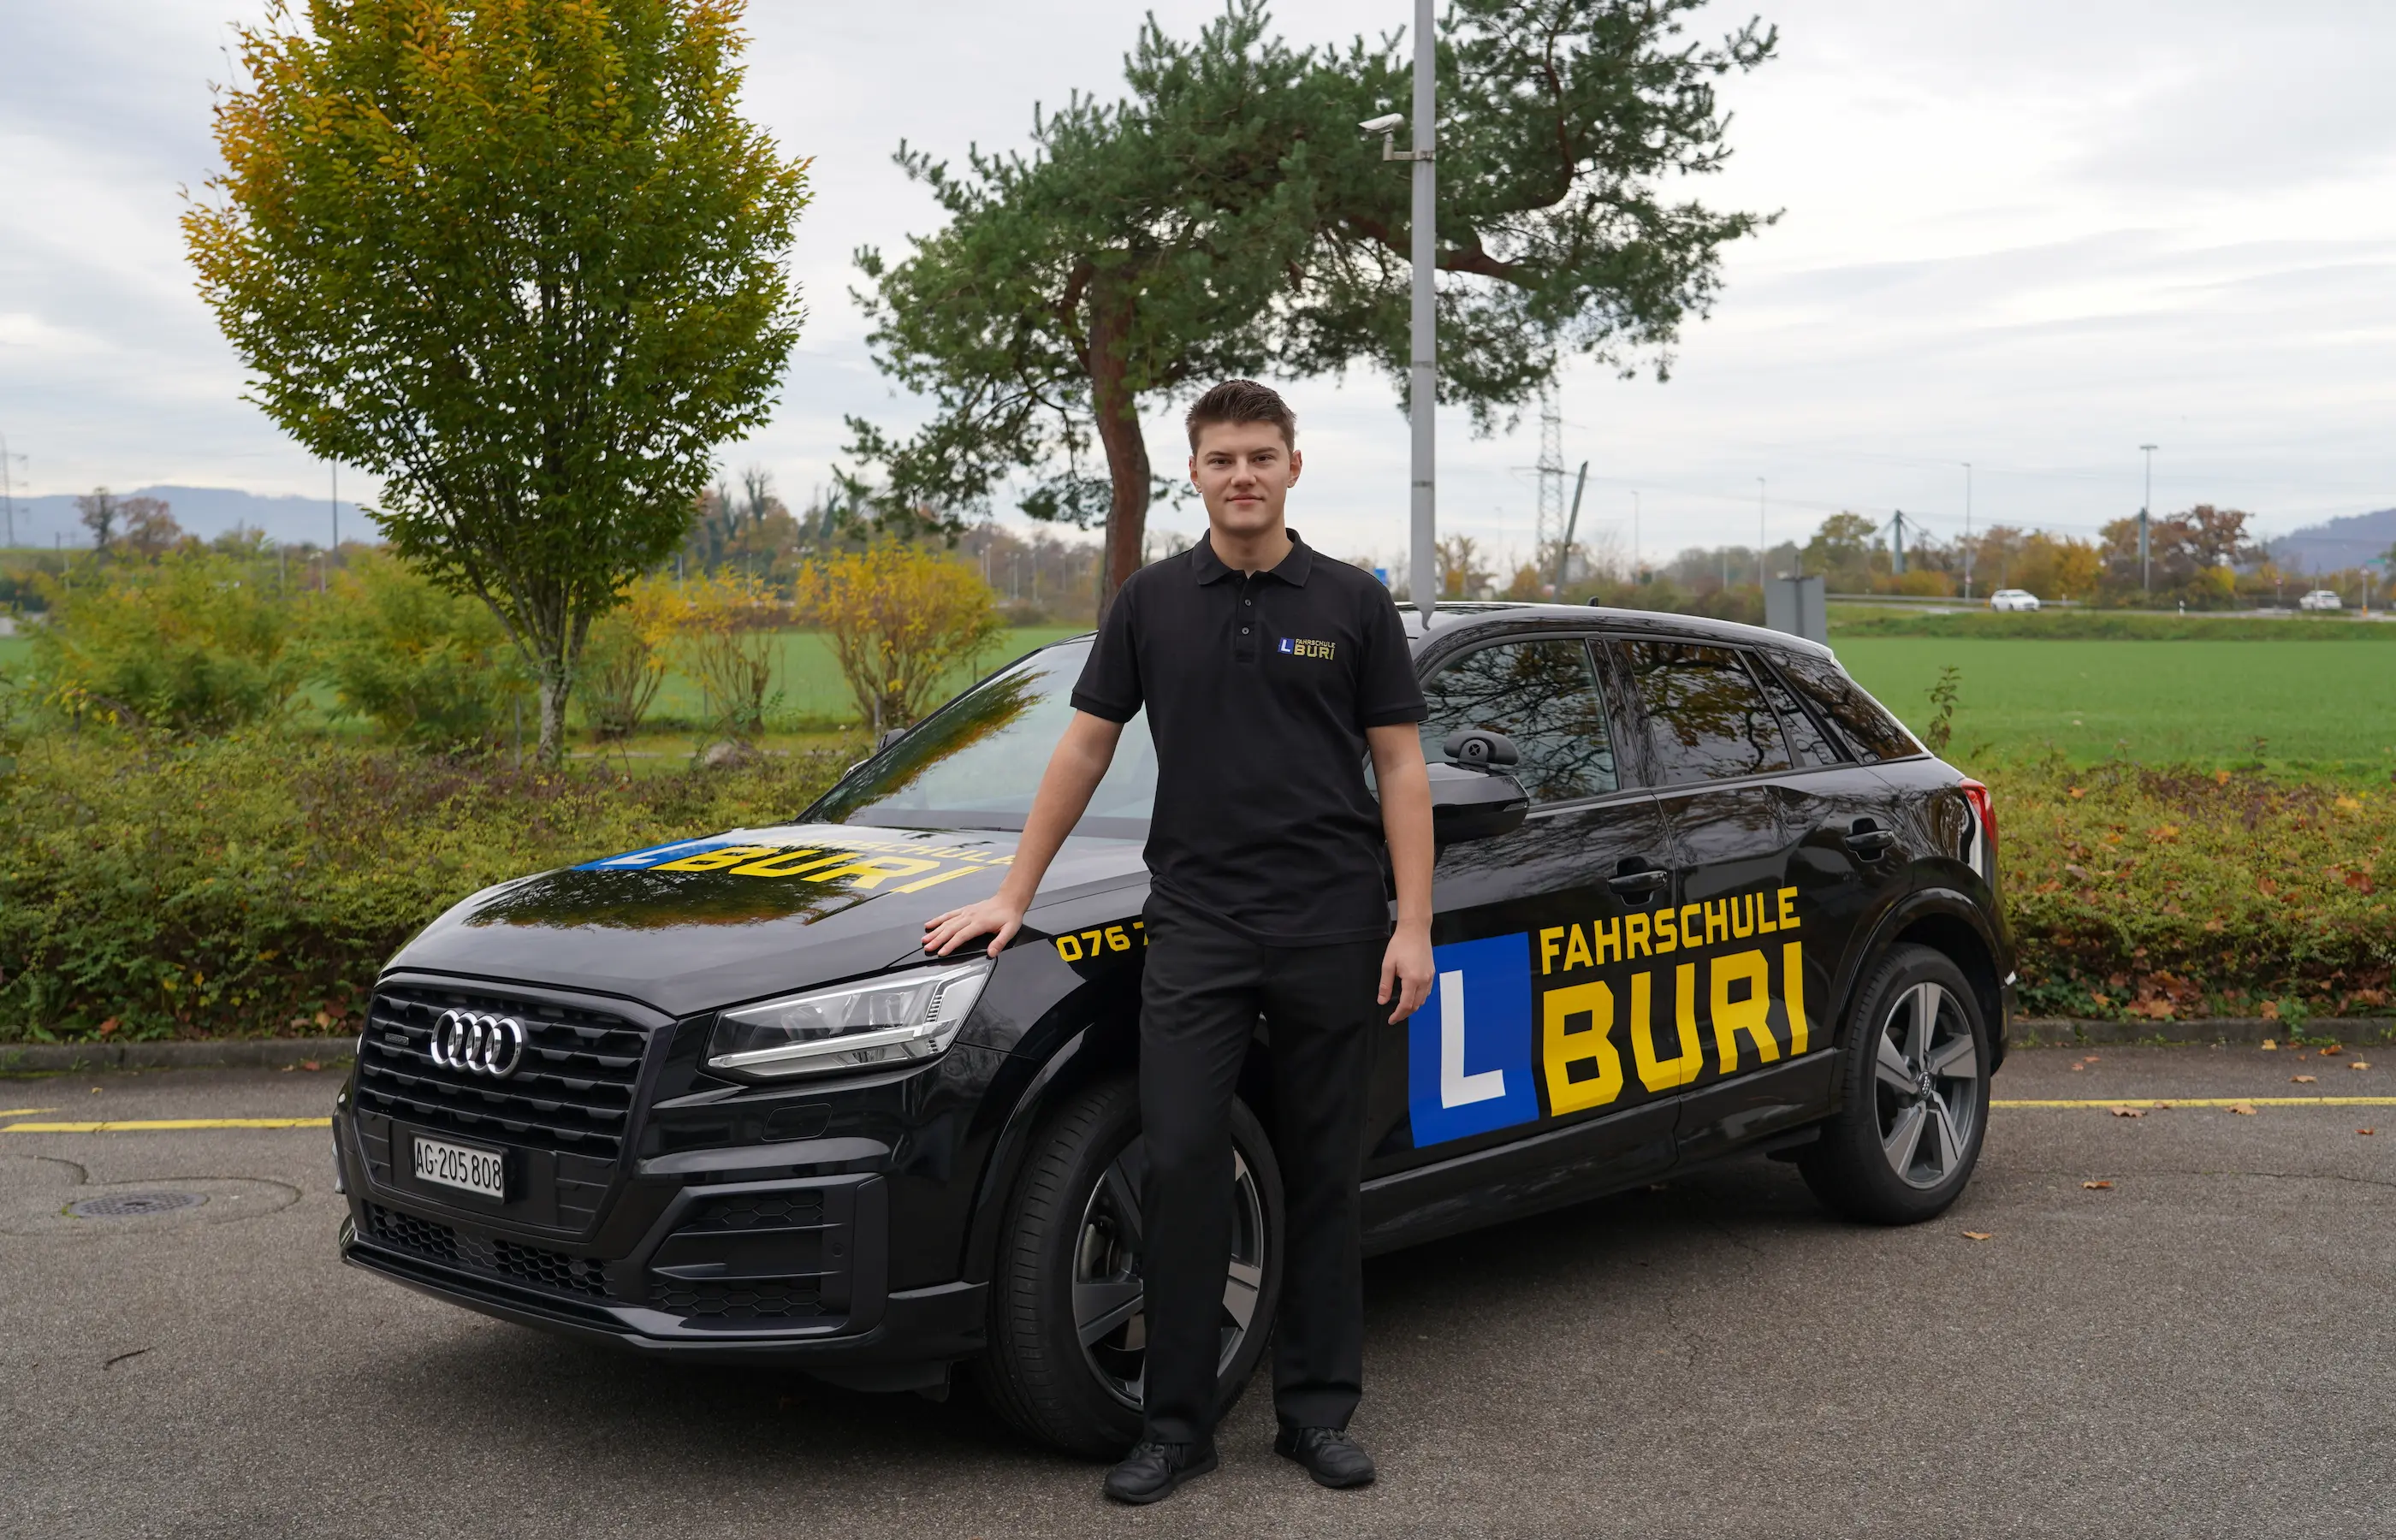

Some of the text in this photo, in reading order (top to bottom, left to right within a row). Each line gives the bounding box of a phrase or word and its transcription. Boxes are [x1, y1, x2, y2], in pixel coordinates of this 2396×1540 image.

[1281, 639, 1290, 652] L
[1294, 644, 1334, 660] BURI
[1296, 638, 1335, 648] FAHRSCHULE
[647, 846, 990, 893] BURI
[744, 838, 1017, 865] HRSCHULE
[1056, 926, 1130, 962] 076
[1539, 886, 1800, 975] FAHRSCHULE
[1439, 969, 1506, 1109] L
[1543, 941, 1808, 1116] BURI
[471, 1154, 501, 1191] 808
